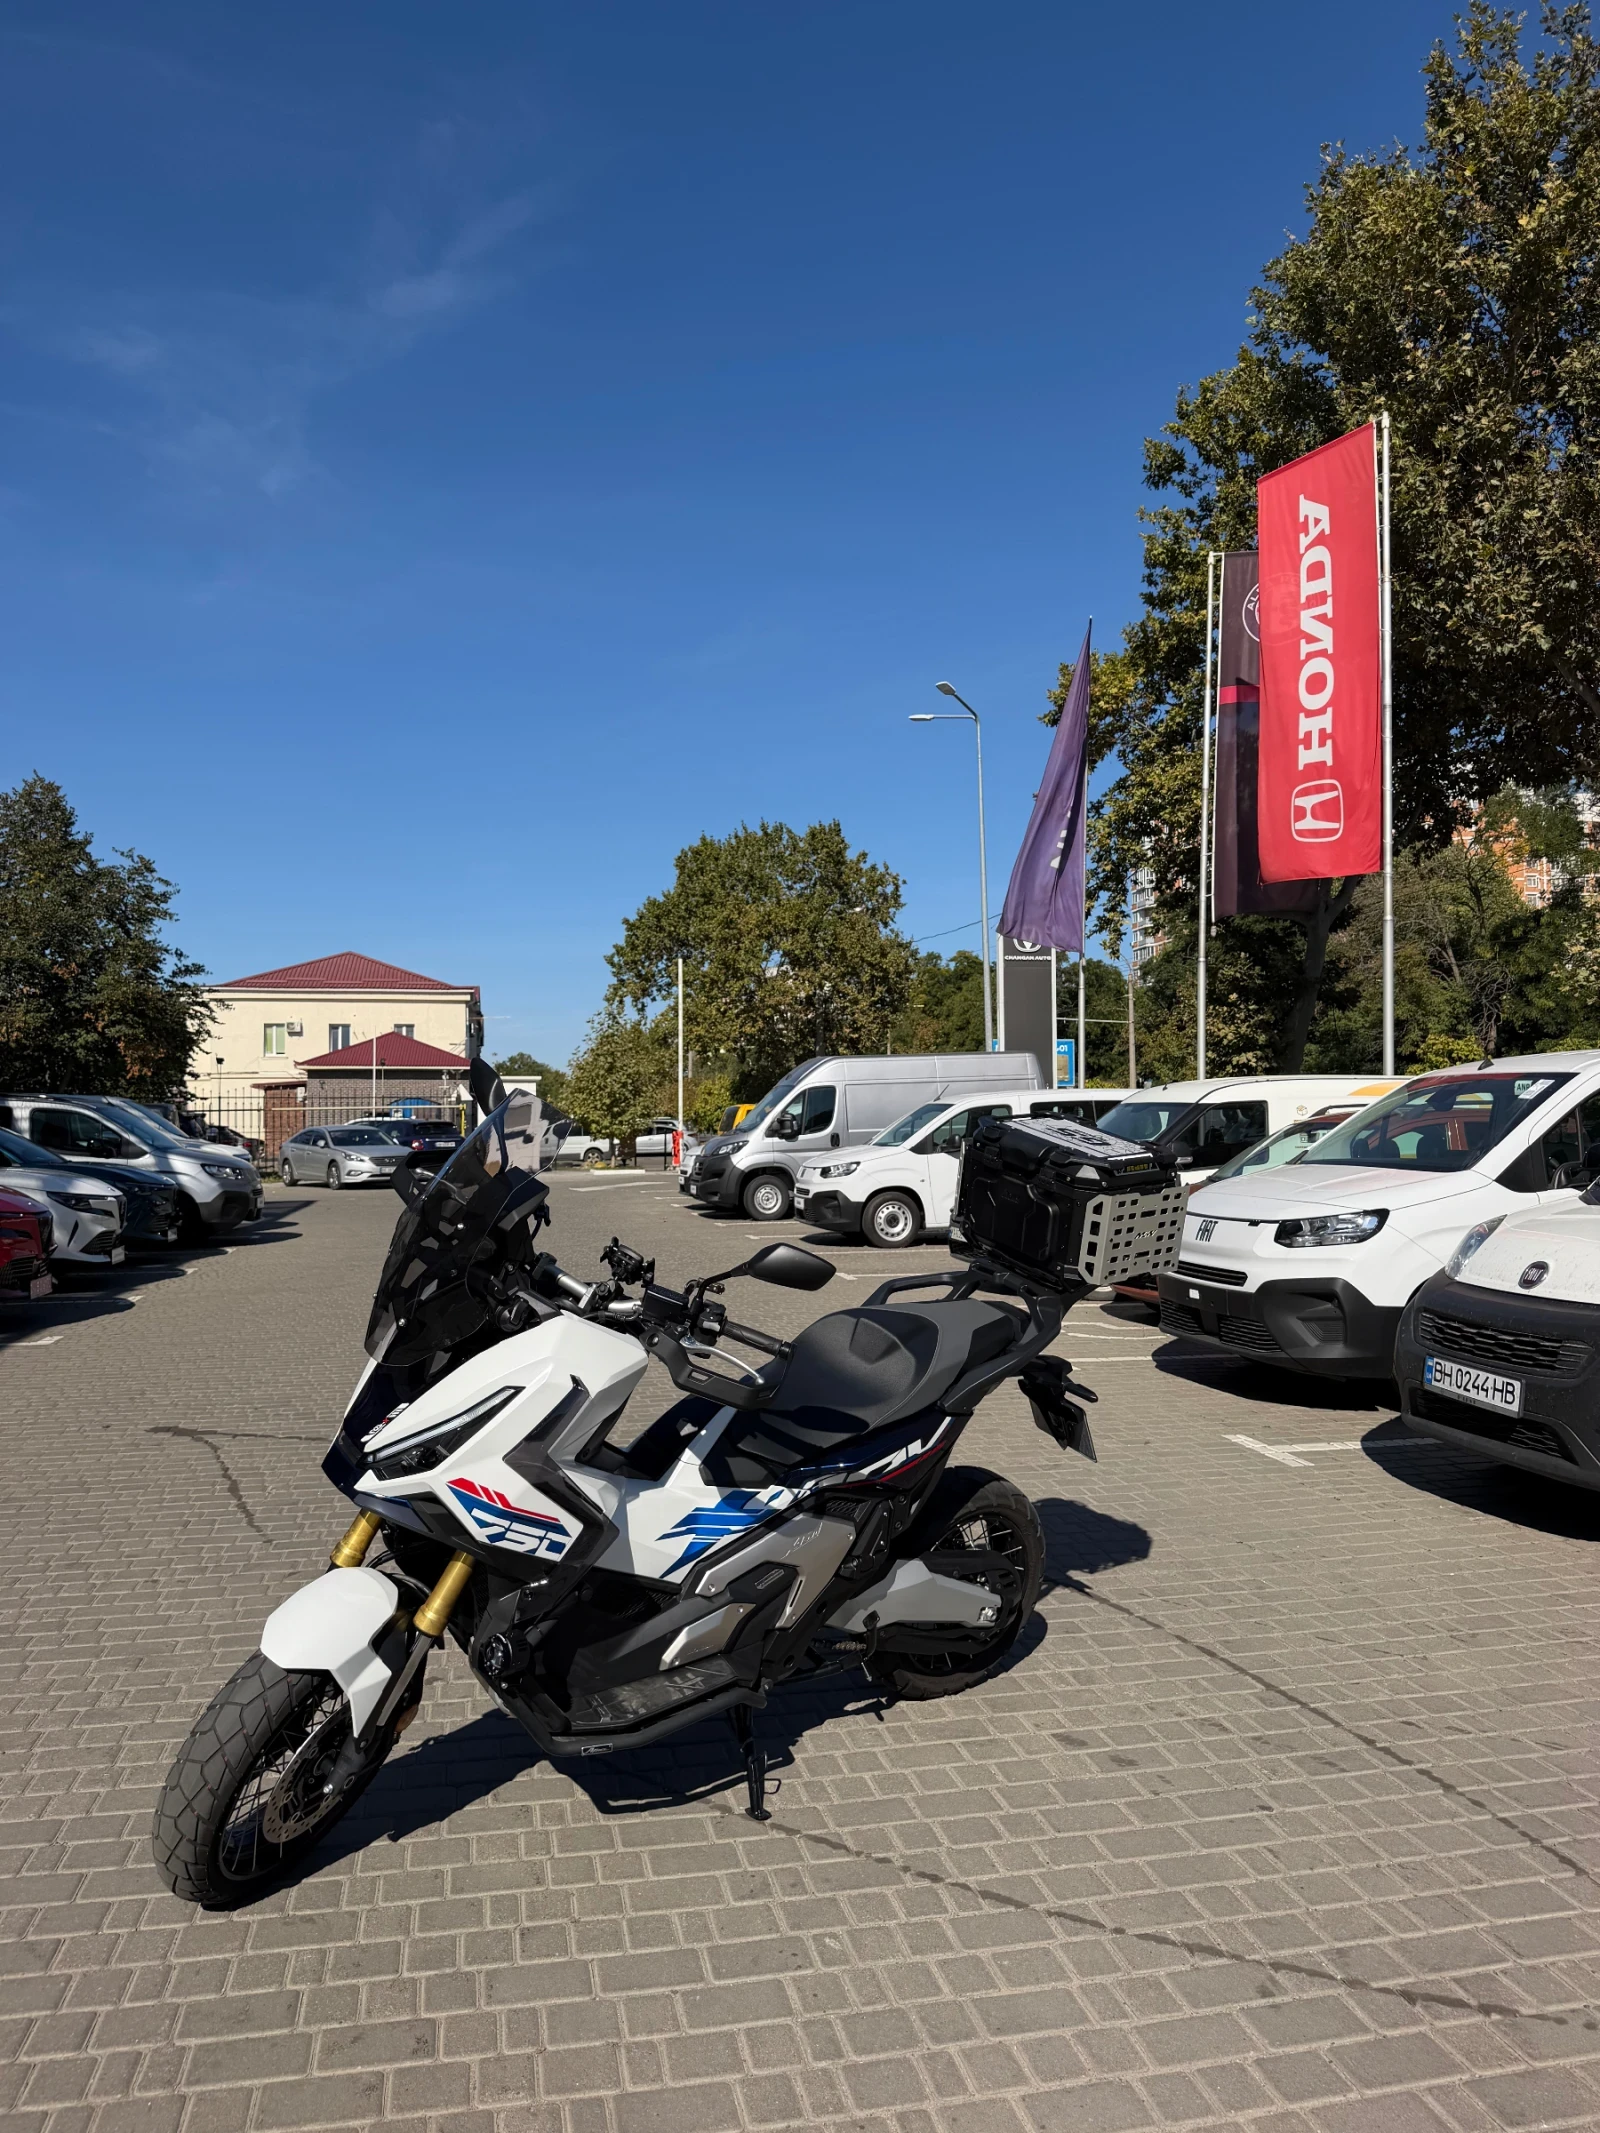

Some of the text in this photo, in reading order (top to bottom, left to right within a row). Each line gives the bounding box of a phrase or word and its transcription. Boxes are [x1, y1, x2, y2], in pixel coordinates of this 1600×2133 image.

[1195, 1219, 1219, 1242] FIAT
[1524, 1267, 1544, 1282] FIAT
[1455, 1368, 1490, 1399] 0244
[470, 1507, 573, 1562] 750
